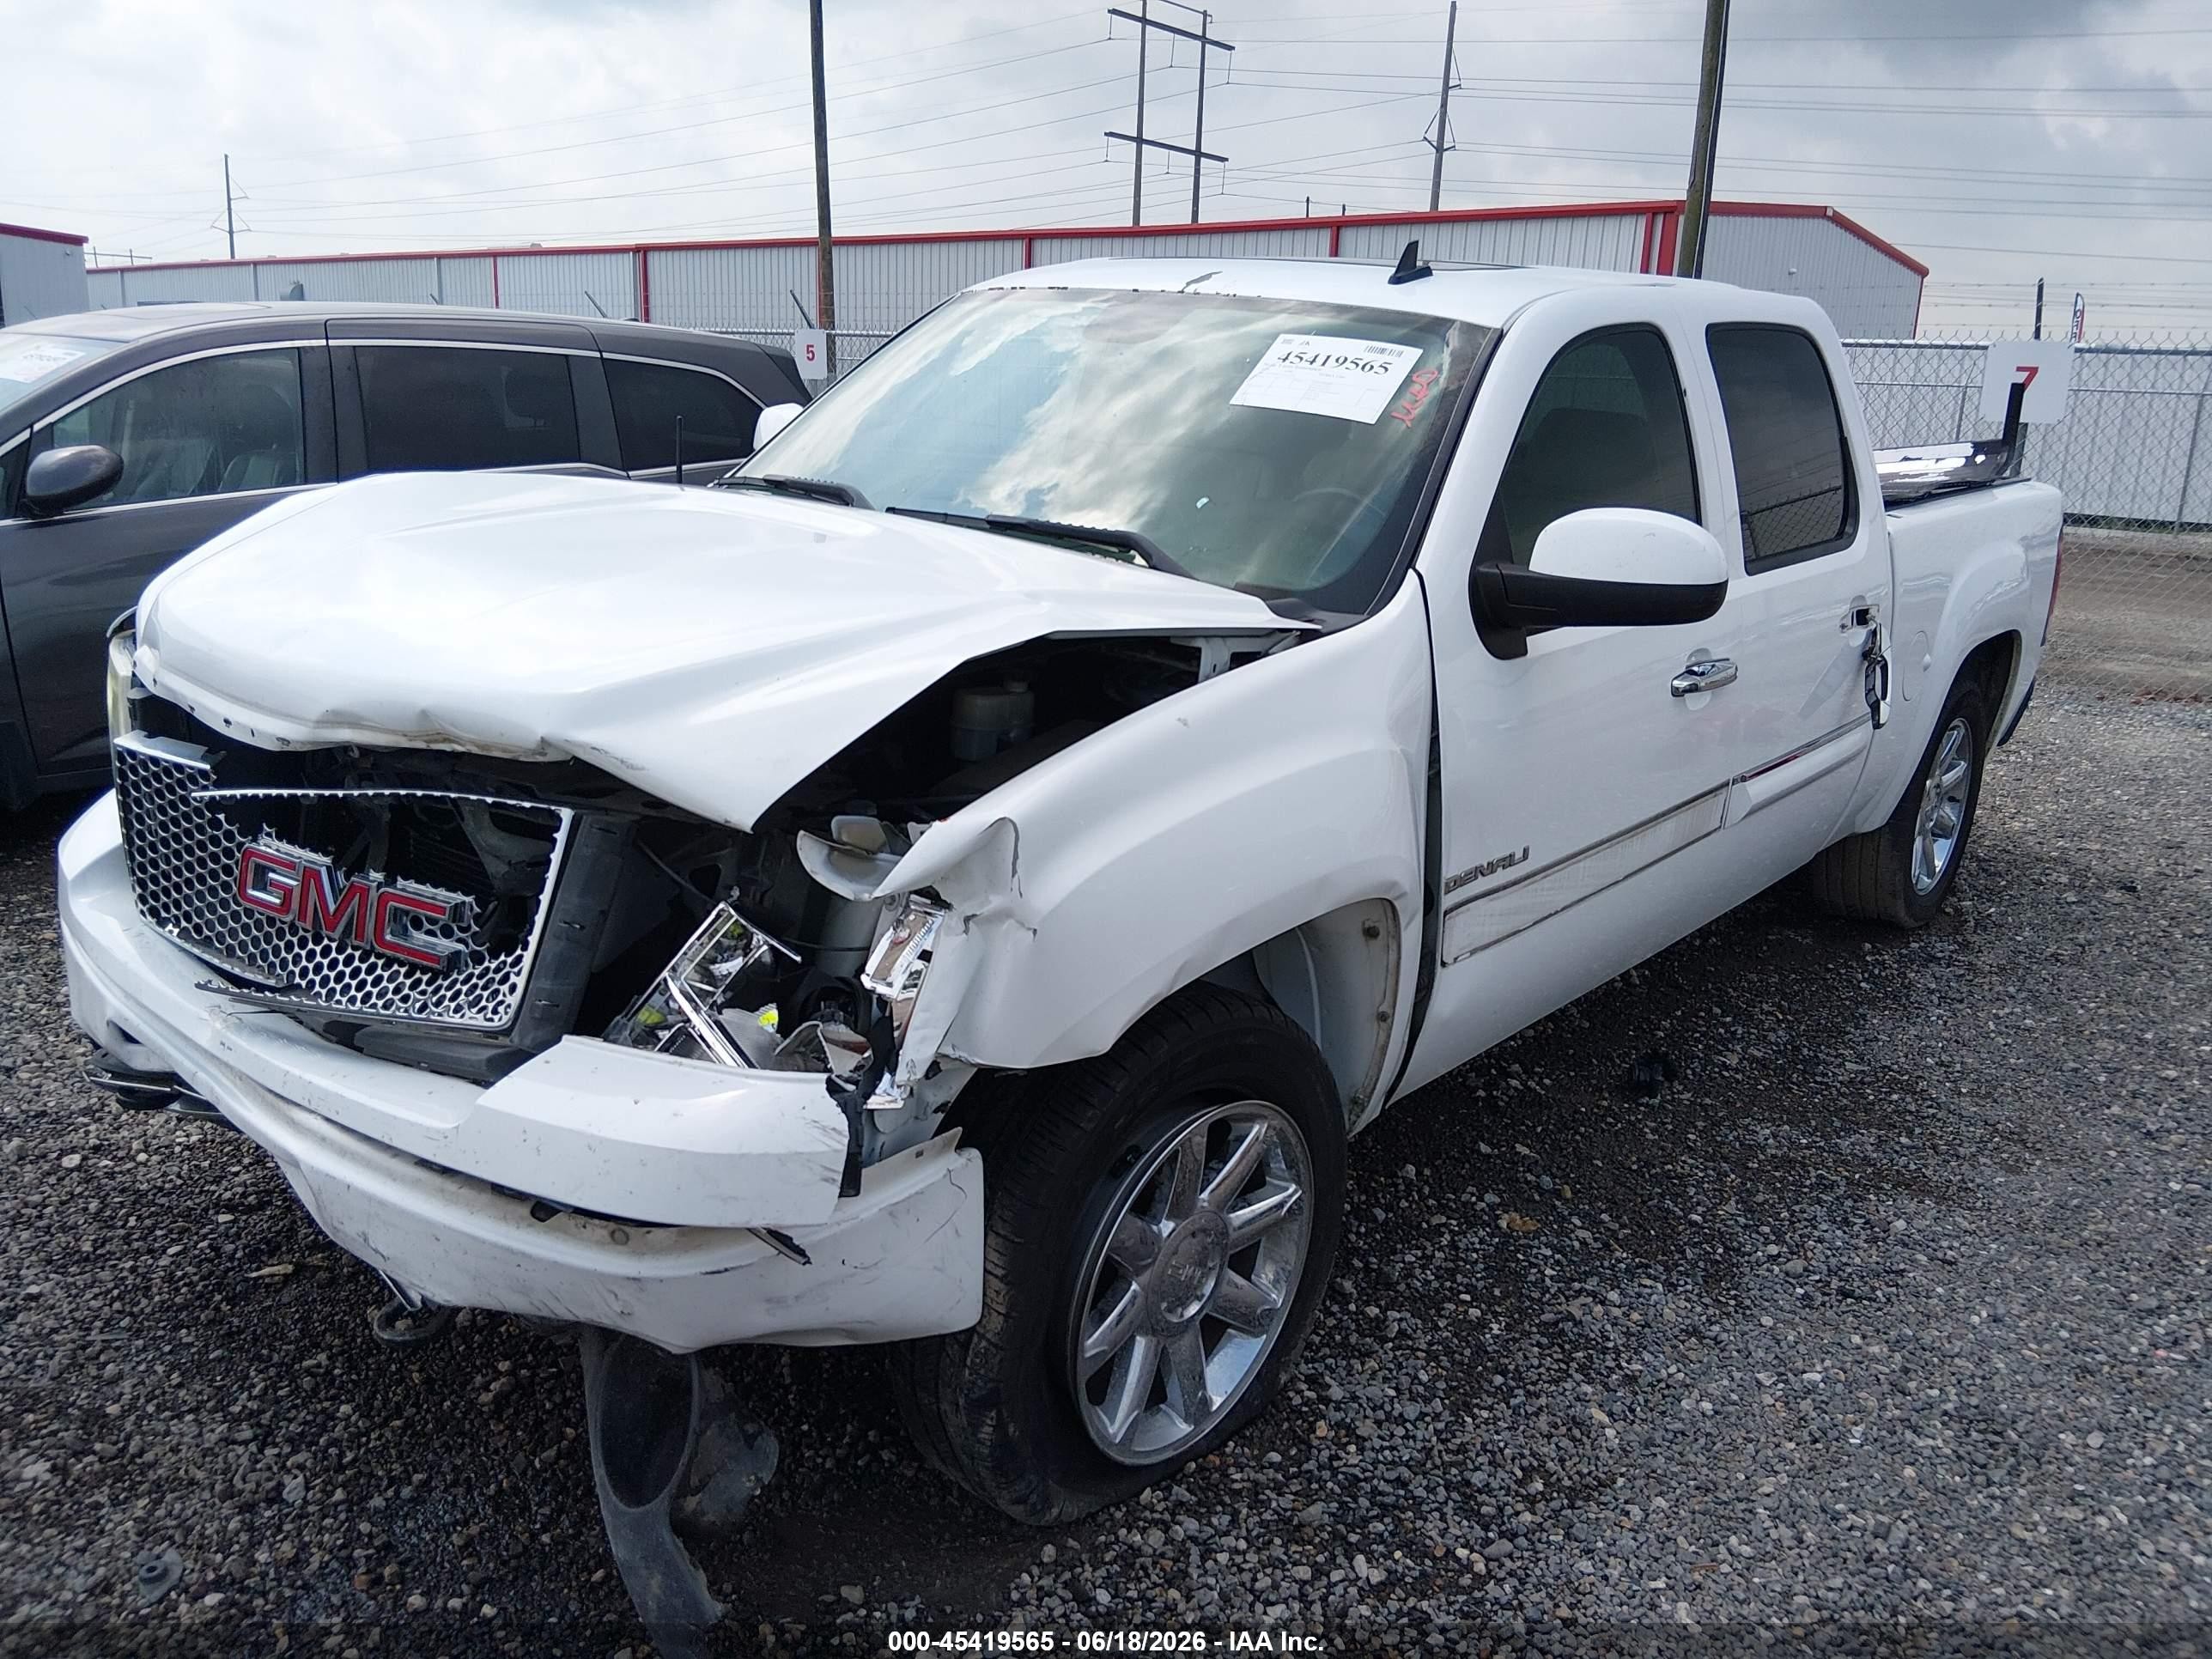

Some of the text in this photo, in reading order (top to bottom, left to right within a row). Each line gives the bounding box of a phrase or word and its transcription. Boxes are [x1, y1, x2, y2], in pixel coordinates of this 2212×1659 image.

[805, 343, 816, 362] 5
[1277, 350, 1394, 376] 45419565
[2015, 366, 2039, 392] 7
[1443, 845, 1530, 896] DENALI
[237, 842, 469, 972] GMC
